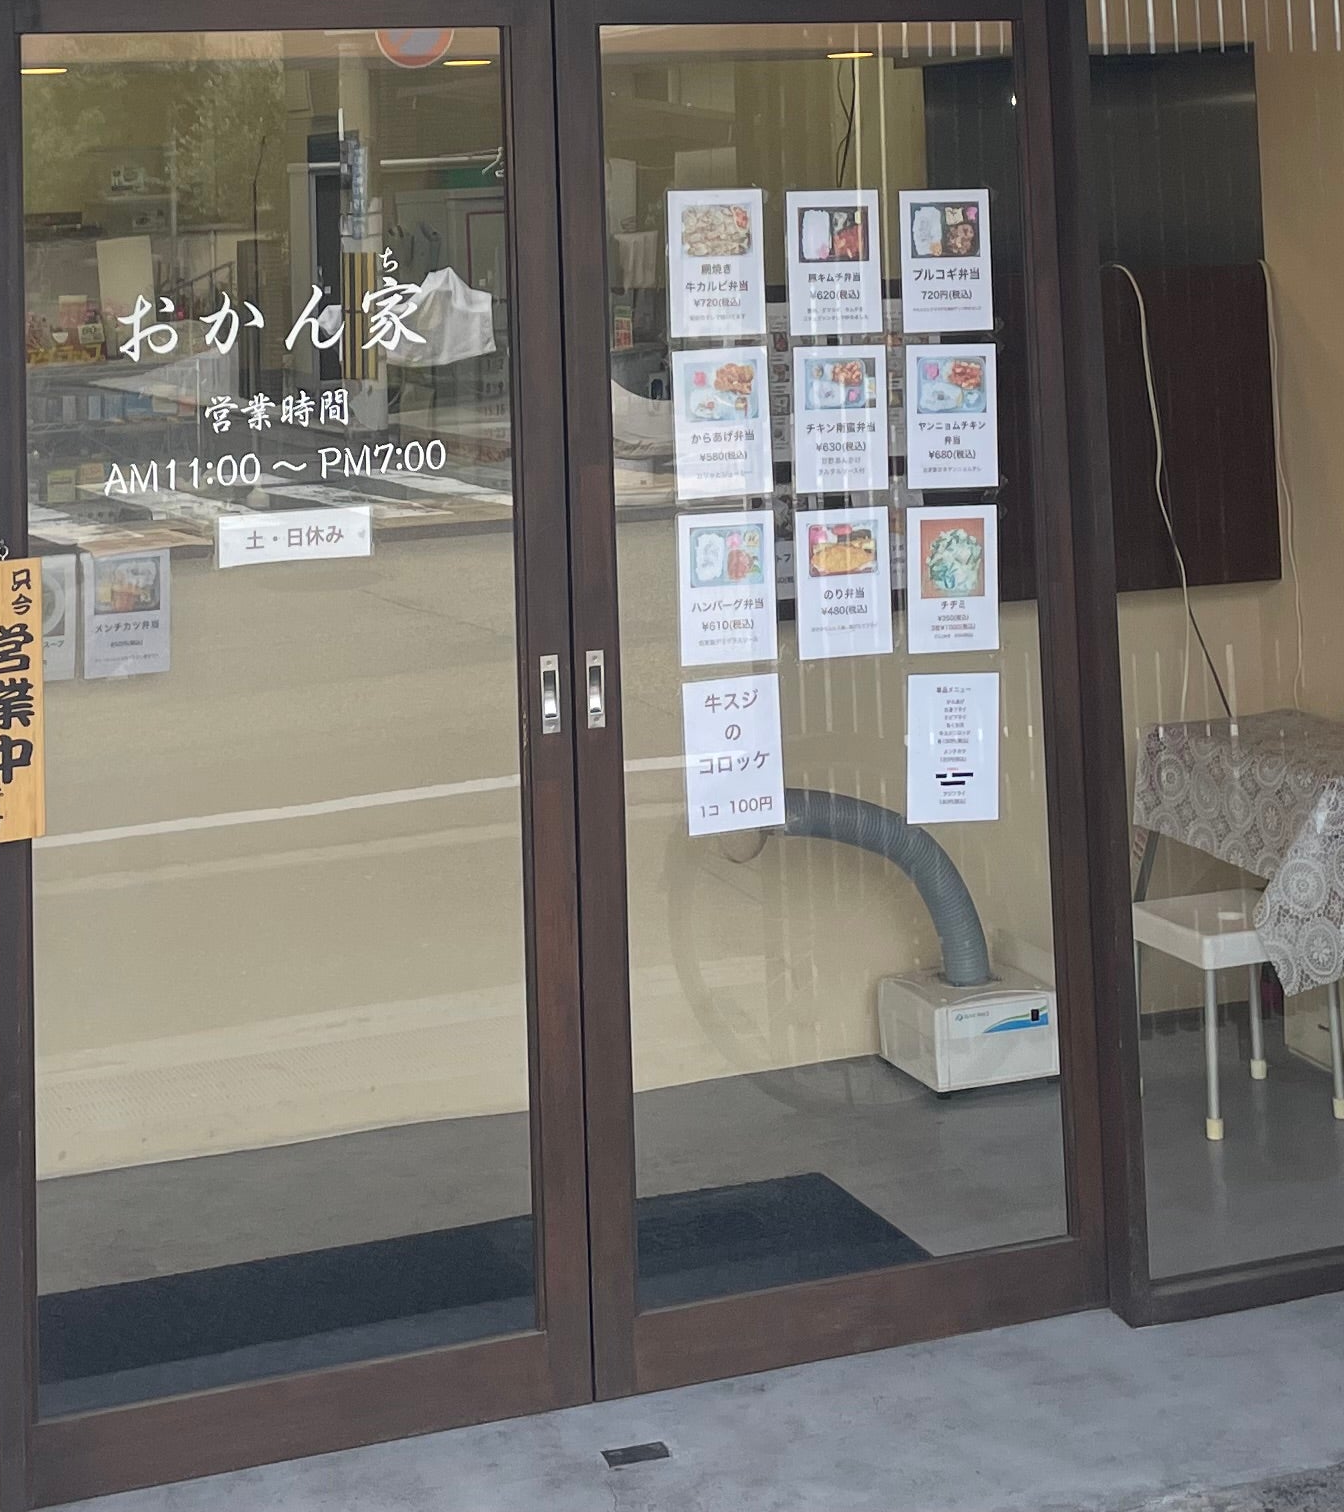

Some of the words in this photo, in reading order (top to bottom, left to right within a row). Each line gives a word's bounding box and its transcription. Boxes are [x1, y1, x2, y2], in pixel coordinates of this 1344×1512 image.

[913, 268, 980, 281] プルコギ弁当
[685, 280, 748, 293] 牛カルビ弁当
[921, 289, 972, 300] 720円(税込)
[116, 277, 427, 363] おかん家
[204, 388, 349, 434] 営業時間
[691, 429, 755, 444] からあげ弁当
[824, 587, 865, 599] のり弁当
[692, 597, 764, 612] ハンバーグ弁当
[941, 600, 966, 609] チヂミ
[704, 689, 758, 714] 牛スジ
[725, 724, 742, 741] の
[699, 750, 771, 776] コロッケ
[730, 796, 773, 814] 100円
